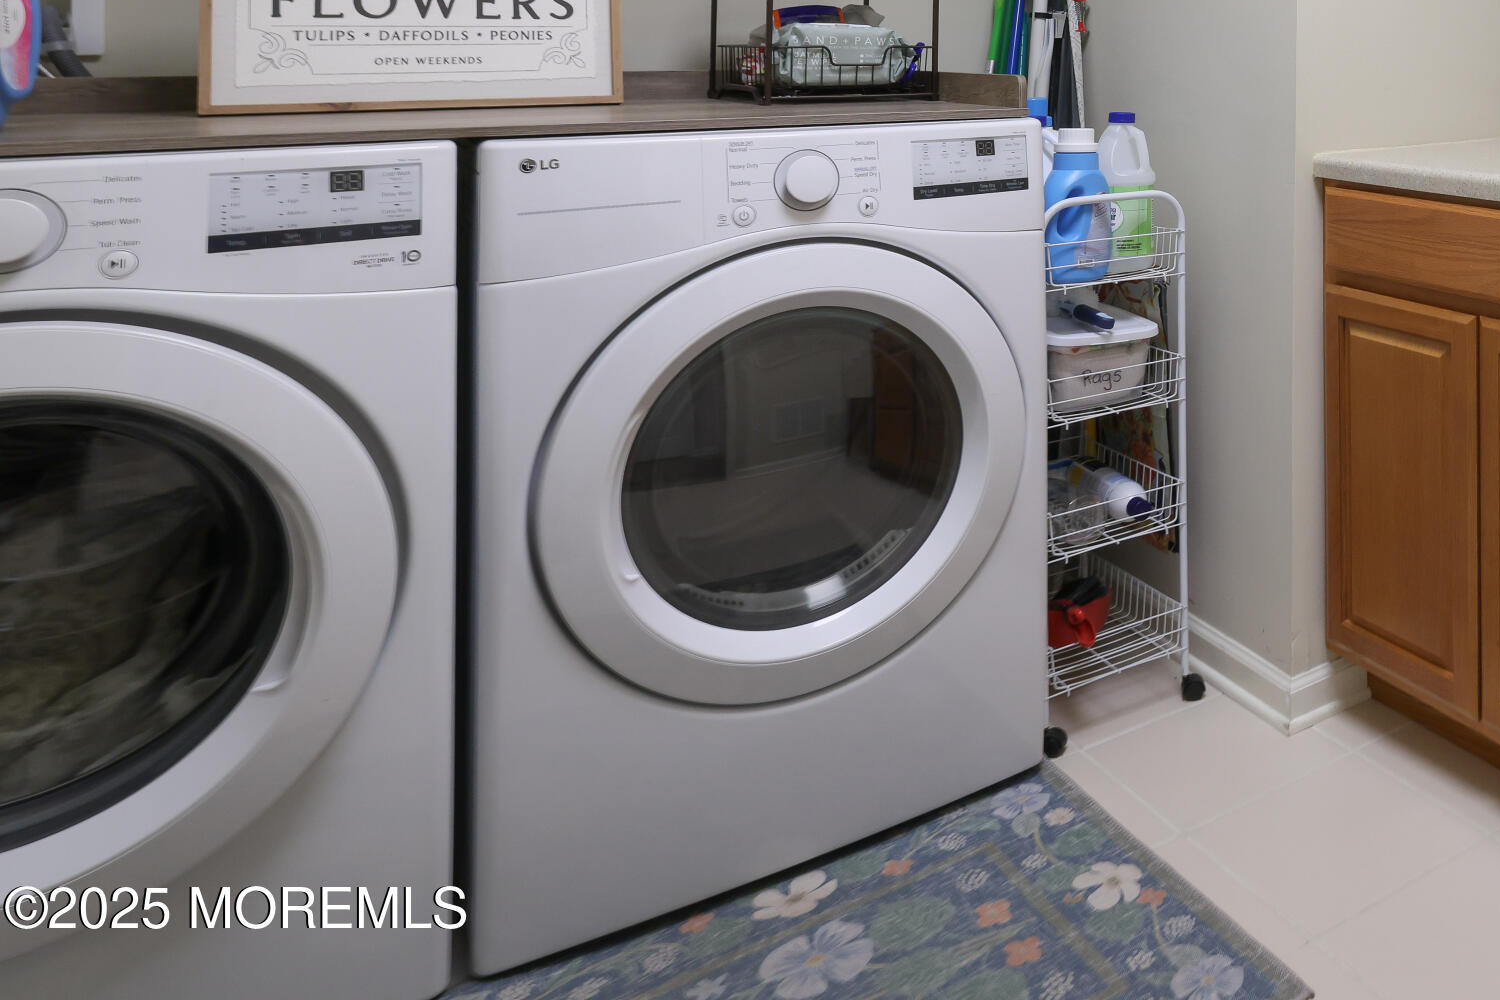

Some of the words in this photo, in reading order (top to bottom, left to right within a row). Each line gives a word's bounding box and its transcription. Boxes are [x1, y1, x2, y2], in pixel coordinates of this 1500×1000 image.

[293, 30, 356, 42] TULIPS
[379, 30, 470, 42] DAFFODILS
[490, 30, 553, 42] PEONIES
[854, 37, 895, 46] PAWS
[374, 56, 410, 66] OPEN
[415, 55, 484, 66] WEEKENDS
[540, 158, 560, 170] LG
[1082, 369, 1122, 391] Rags
